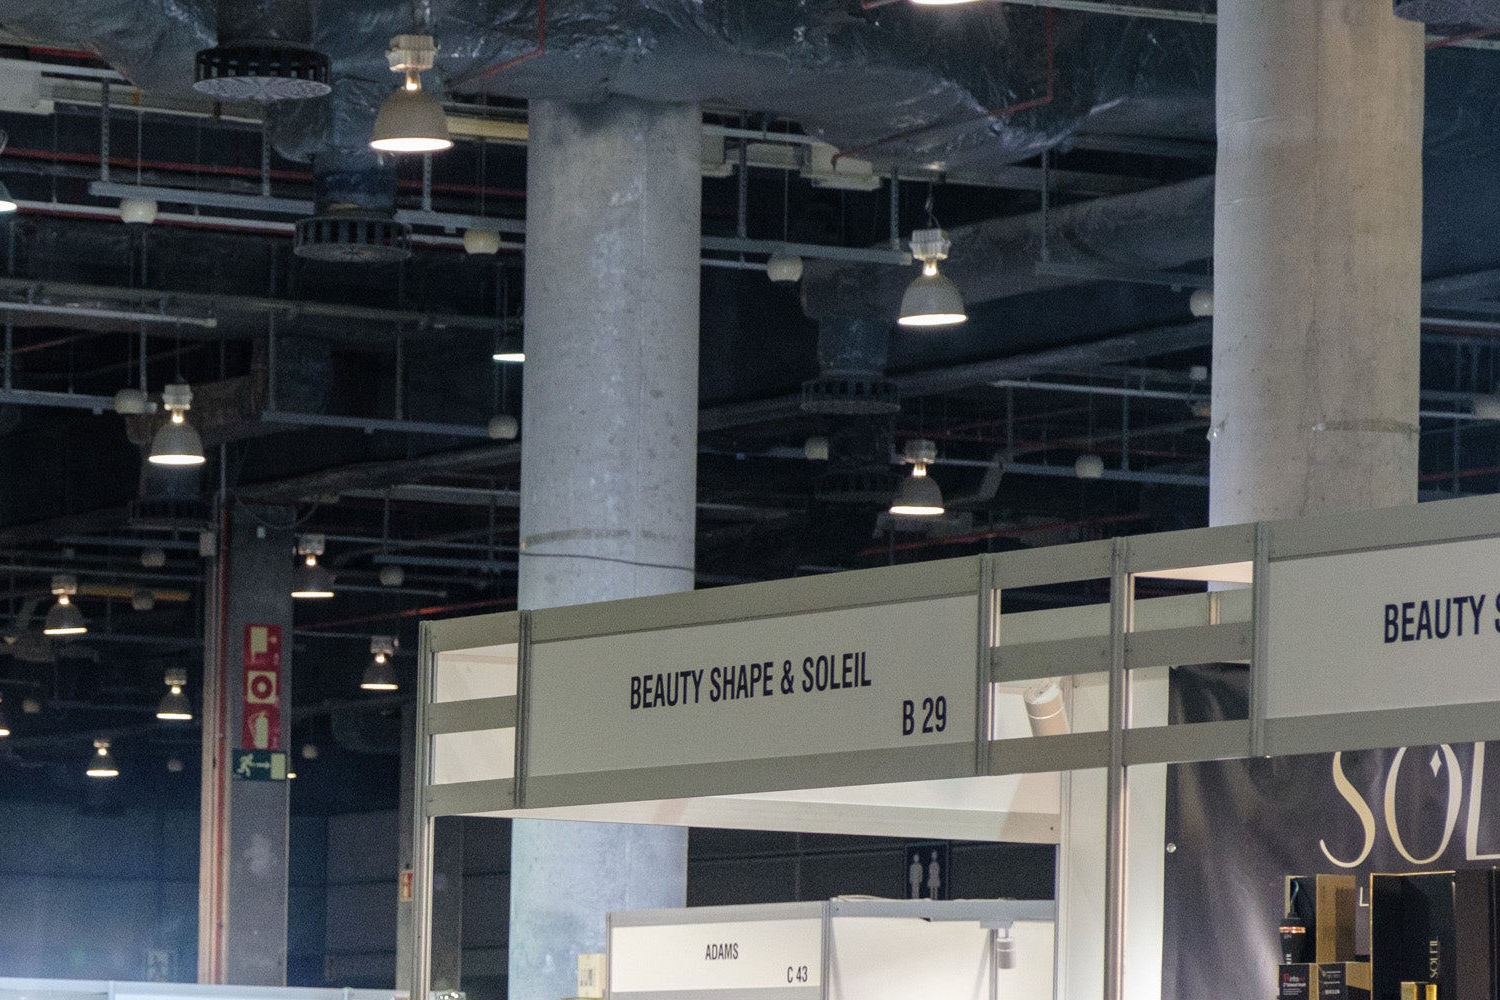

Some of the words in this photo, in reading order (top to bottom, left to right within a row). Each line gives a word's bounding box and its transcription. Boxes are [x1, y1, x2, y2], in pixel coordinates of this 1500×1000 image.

[1384, 595, 1485, 643] BEAUTY
[630, 669, 704, 710] BEAUTY
[710, 662, 774, 702] SHAPE
[781, 660, 795, 695] &
[802, 651, 872, 693] SOLEIL
[902, 700, 915, 736] B
[922, 696, 947, 734] 29
[705, 943, 739, 960] ADAMS
[787, 966, 793, 983] C
[796, 965, 808, 982] 43
